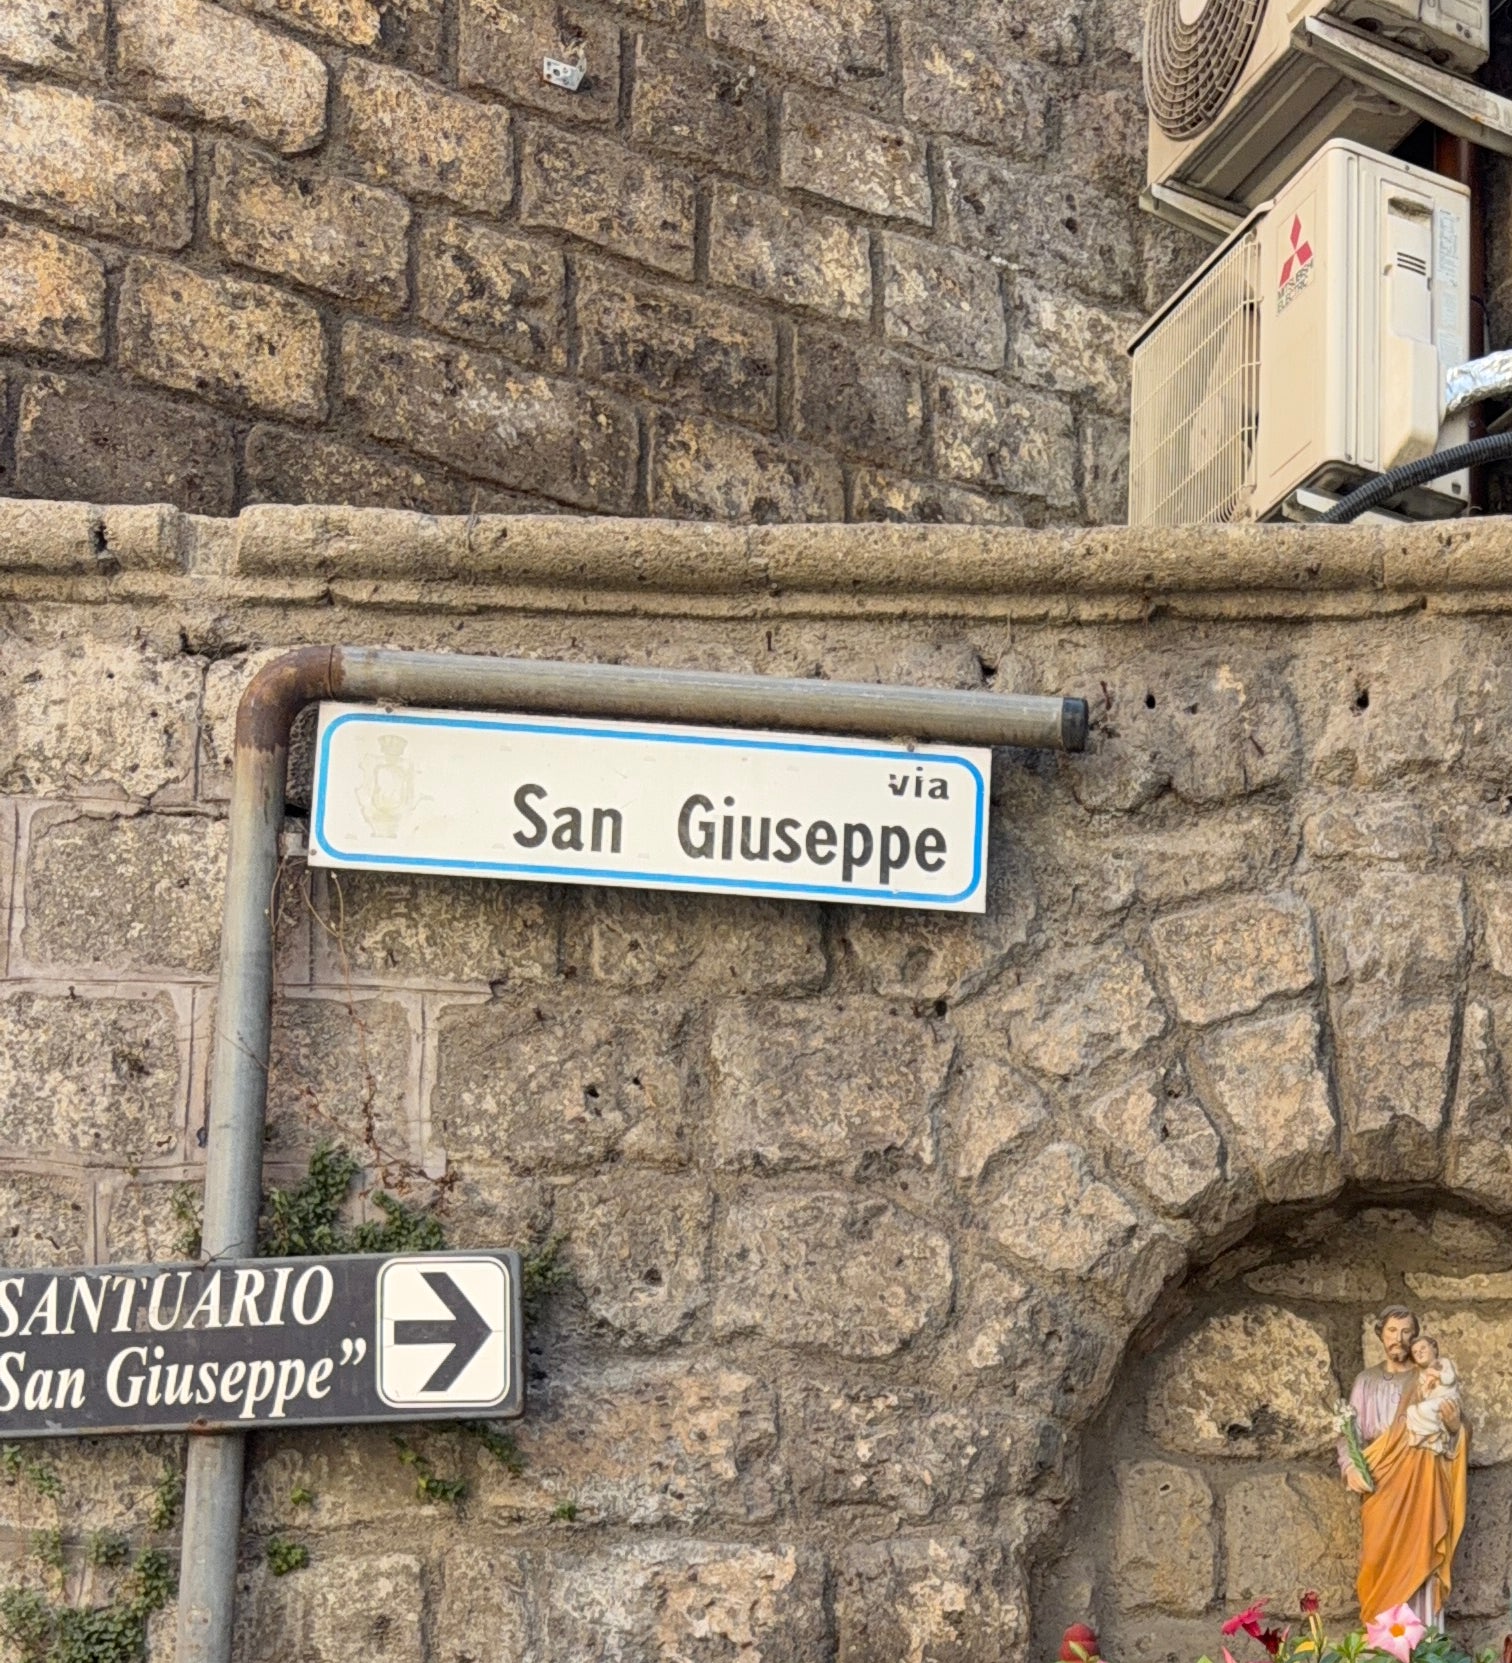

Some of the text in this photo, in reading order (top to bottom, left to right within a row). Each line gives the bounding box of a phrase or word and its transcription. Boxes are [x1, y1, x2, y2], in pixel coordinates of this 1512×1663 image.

[888, 766, 950, 800] via
[511, 783, 948, 885] San Giuseppe
[0, 1265, 334, 1338] SANTUARIO
[0, 1350, 87, 1412] San
